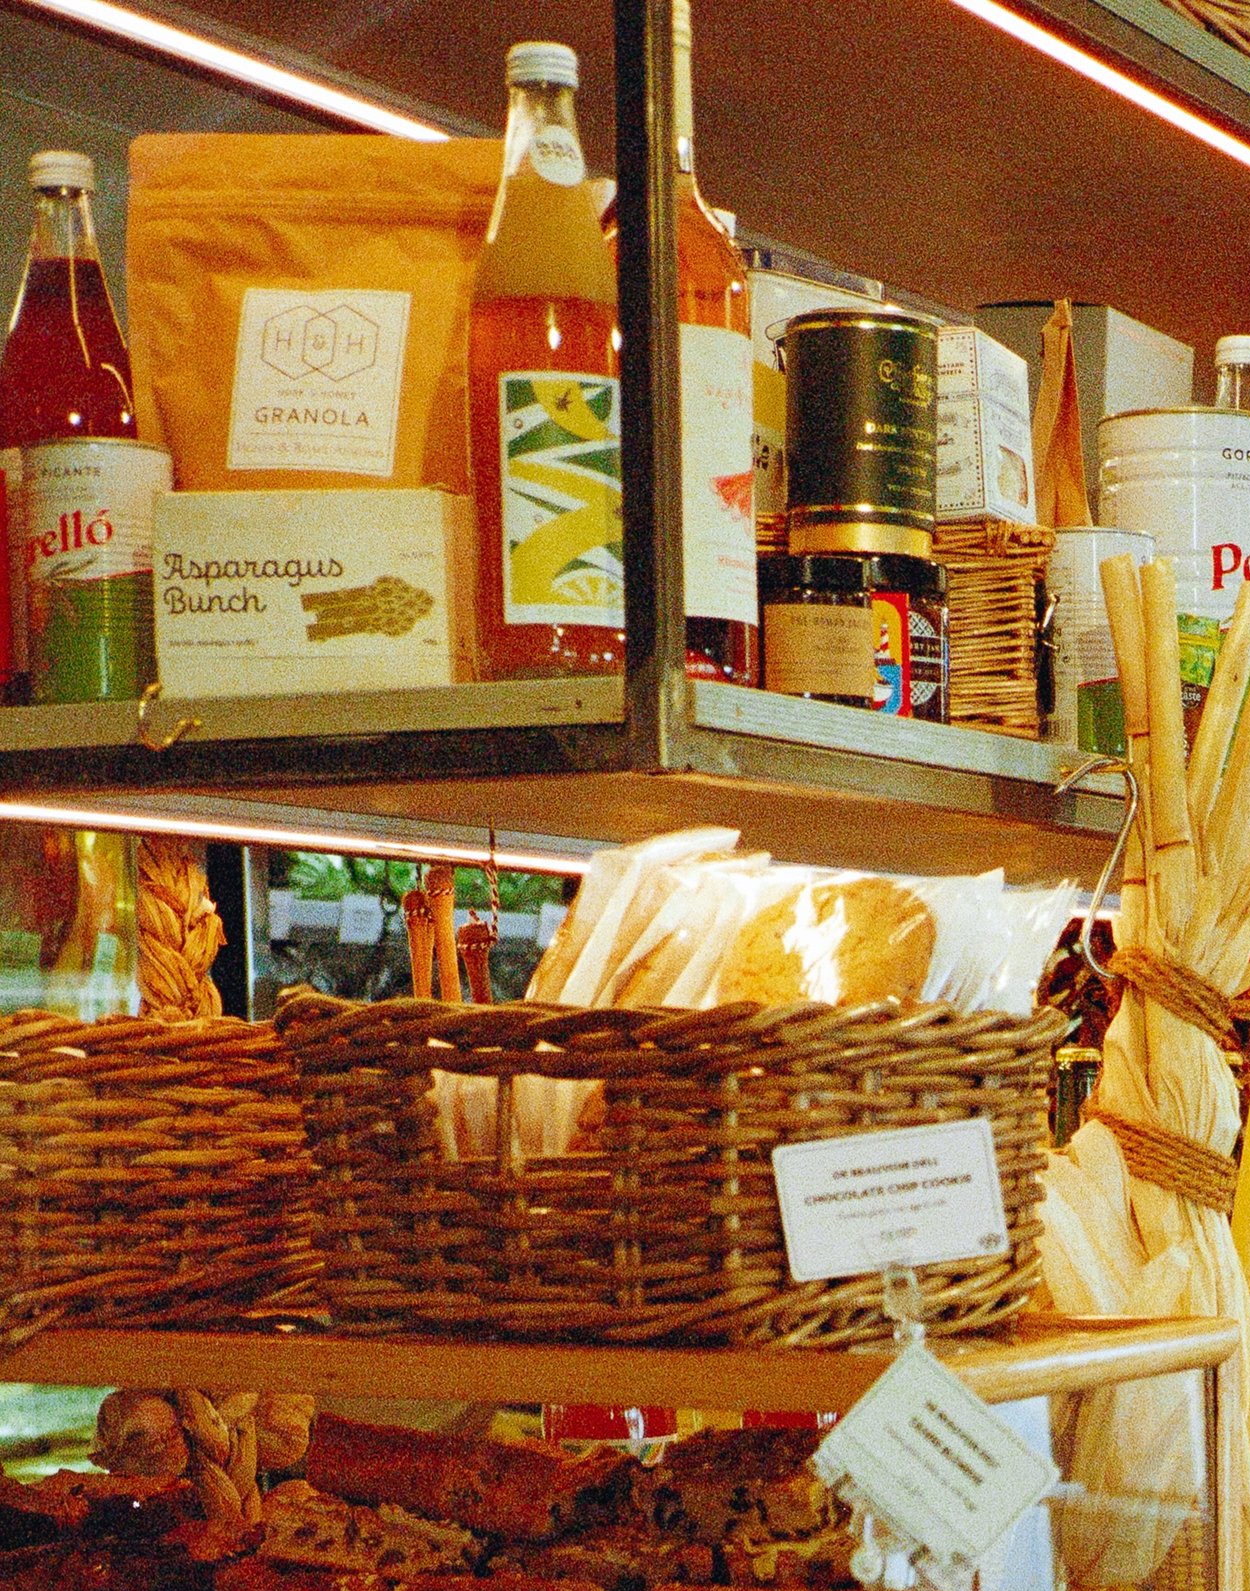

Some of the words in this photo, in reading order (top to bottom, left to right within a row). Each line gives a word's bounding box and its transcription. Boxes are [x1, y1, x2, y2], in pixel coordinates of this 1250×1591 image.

[274, 331, 292, 352] H
[346, 333, 365, 354] H
[255, 406, 369, 427] GRANOLA
[163, 552, 346, 589] Asparagus
[163, 586, 267, 615] Bunch
